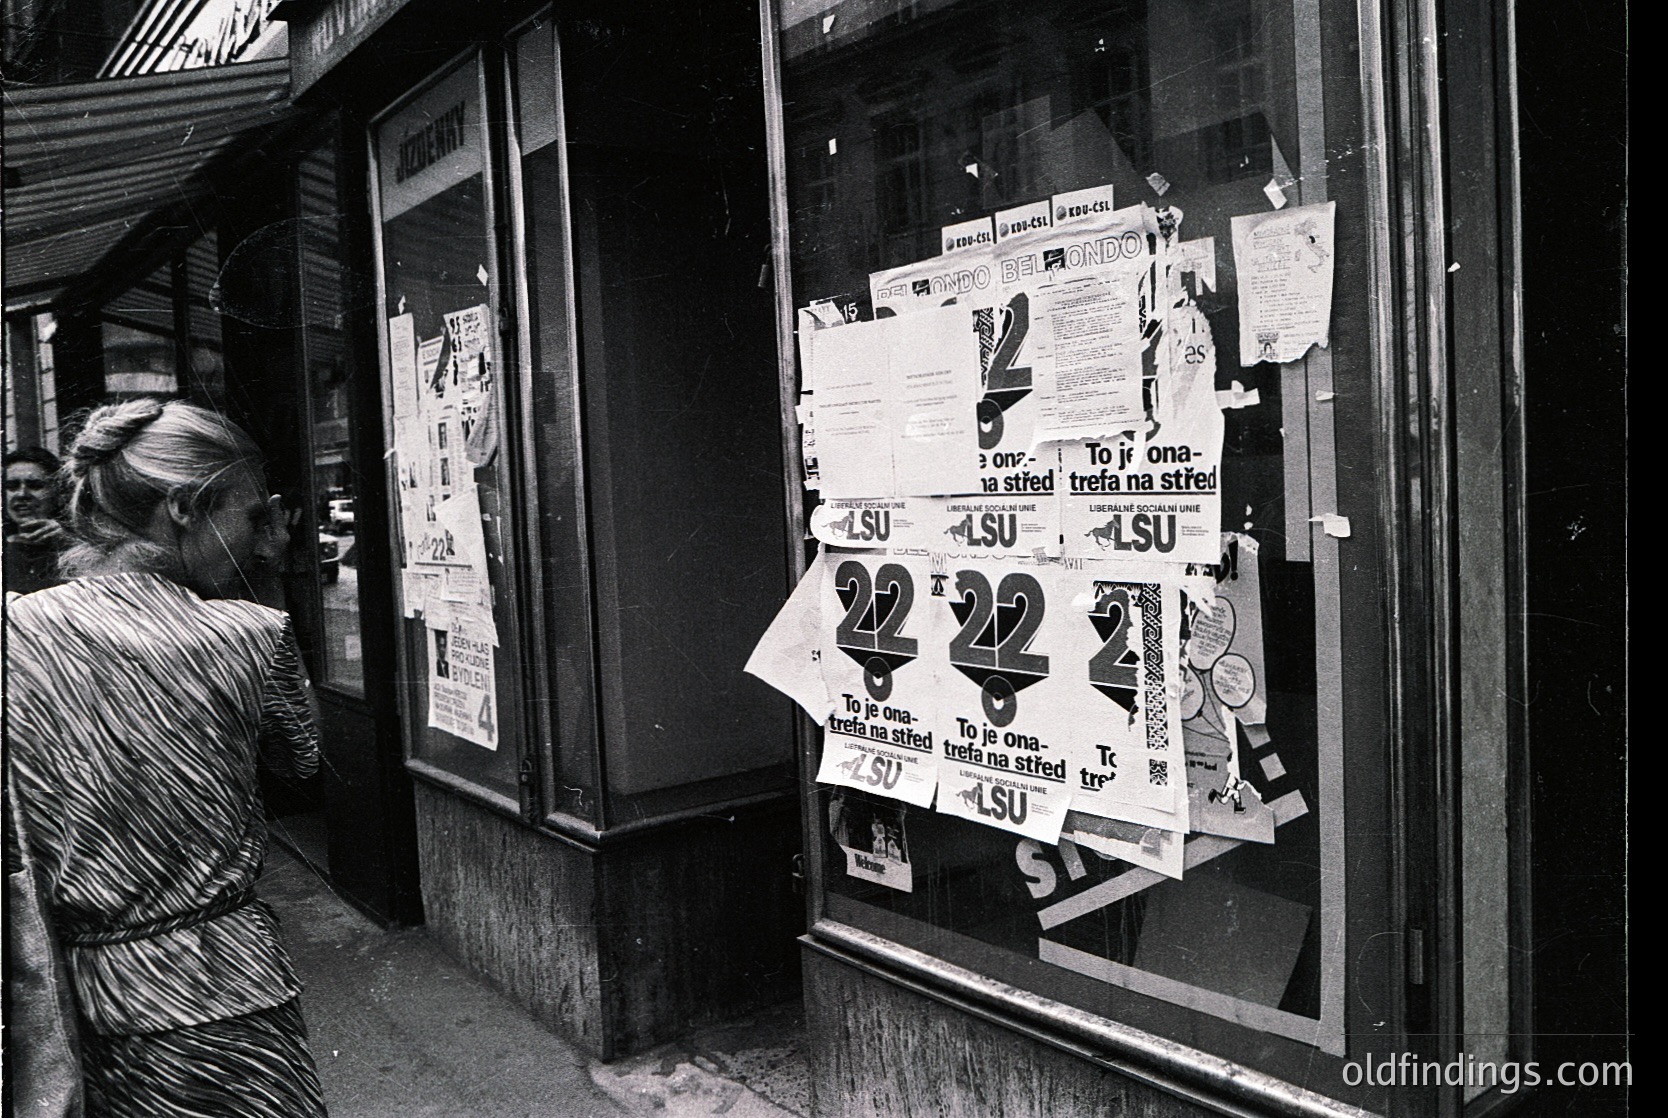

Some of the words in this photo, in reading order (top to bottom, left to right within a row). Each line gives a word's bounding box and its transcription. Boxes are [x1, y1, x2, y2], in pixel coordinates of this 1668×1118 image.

[1010, 216, 1048, 234] KDU-ČSL
[1069, 200, 1111, 218] KDU-ČSL
[956, 231, 992, 248] KDU-ČSL
[1001, 230, 1142, 284] BELONDO
[1085, 442, 1112, 465] To
[1147, 444, 1202, 464] ona-
[1003, 468, 1054, 492] střed
[1069, 468, 1120, 491] trefa
[1127, 473, 1154, 490] na
[1160, 464, 1217, 491] střed
[1019, 504, 1037, 512] UNIE
[1179, 504, 1201, 513] UNIE
[846, 509, 890, 542] LSU
[966, 513, 1017, 548] LSU
[1113, 513, 1176, 553] LSU
[835, 560, 919, 656] 22
[949, 569, 1050, 675] 22
[478, 693, 495, 742] 4
[842, 693, 861, 713] To
[864, 698, 879, 720] je
[883, 706, 919, 725] ona-
[828, 713, 866, 736] trefa
[870, 724, 888, 740] na
[892, 727, 933, 750] střed
[956, 717, 978, 740] To
[982, 723, 998, 747] je
[1004, 731, 1049, 752] ona-
[850, 753, 903, 790] LSU
[943, 739, 983, 763] trefa
[987, 751, 1010, 769] na
[1015, 756, 1066, 779] střed
[977, 782, 1028, 826] LSU
[1029, 784, 1048, 795] UNIE
